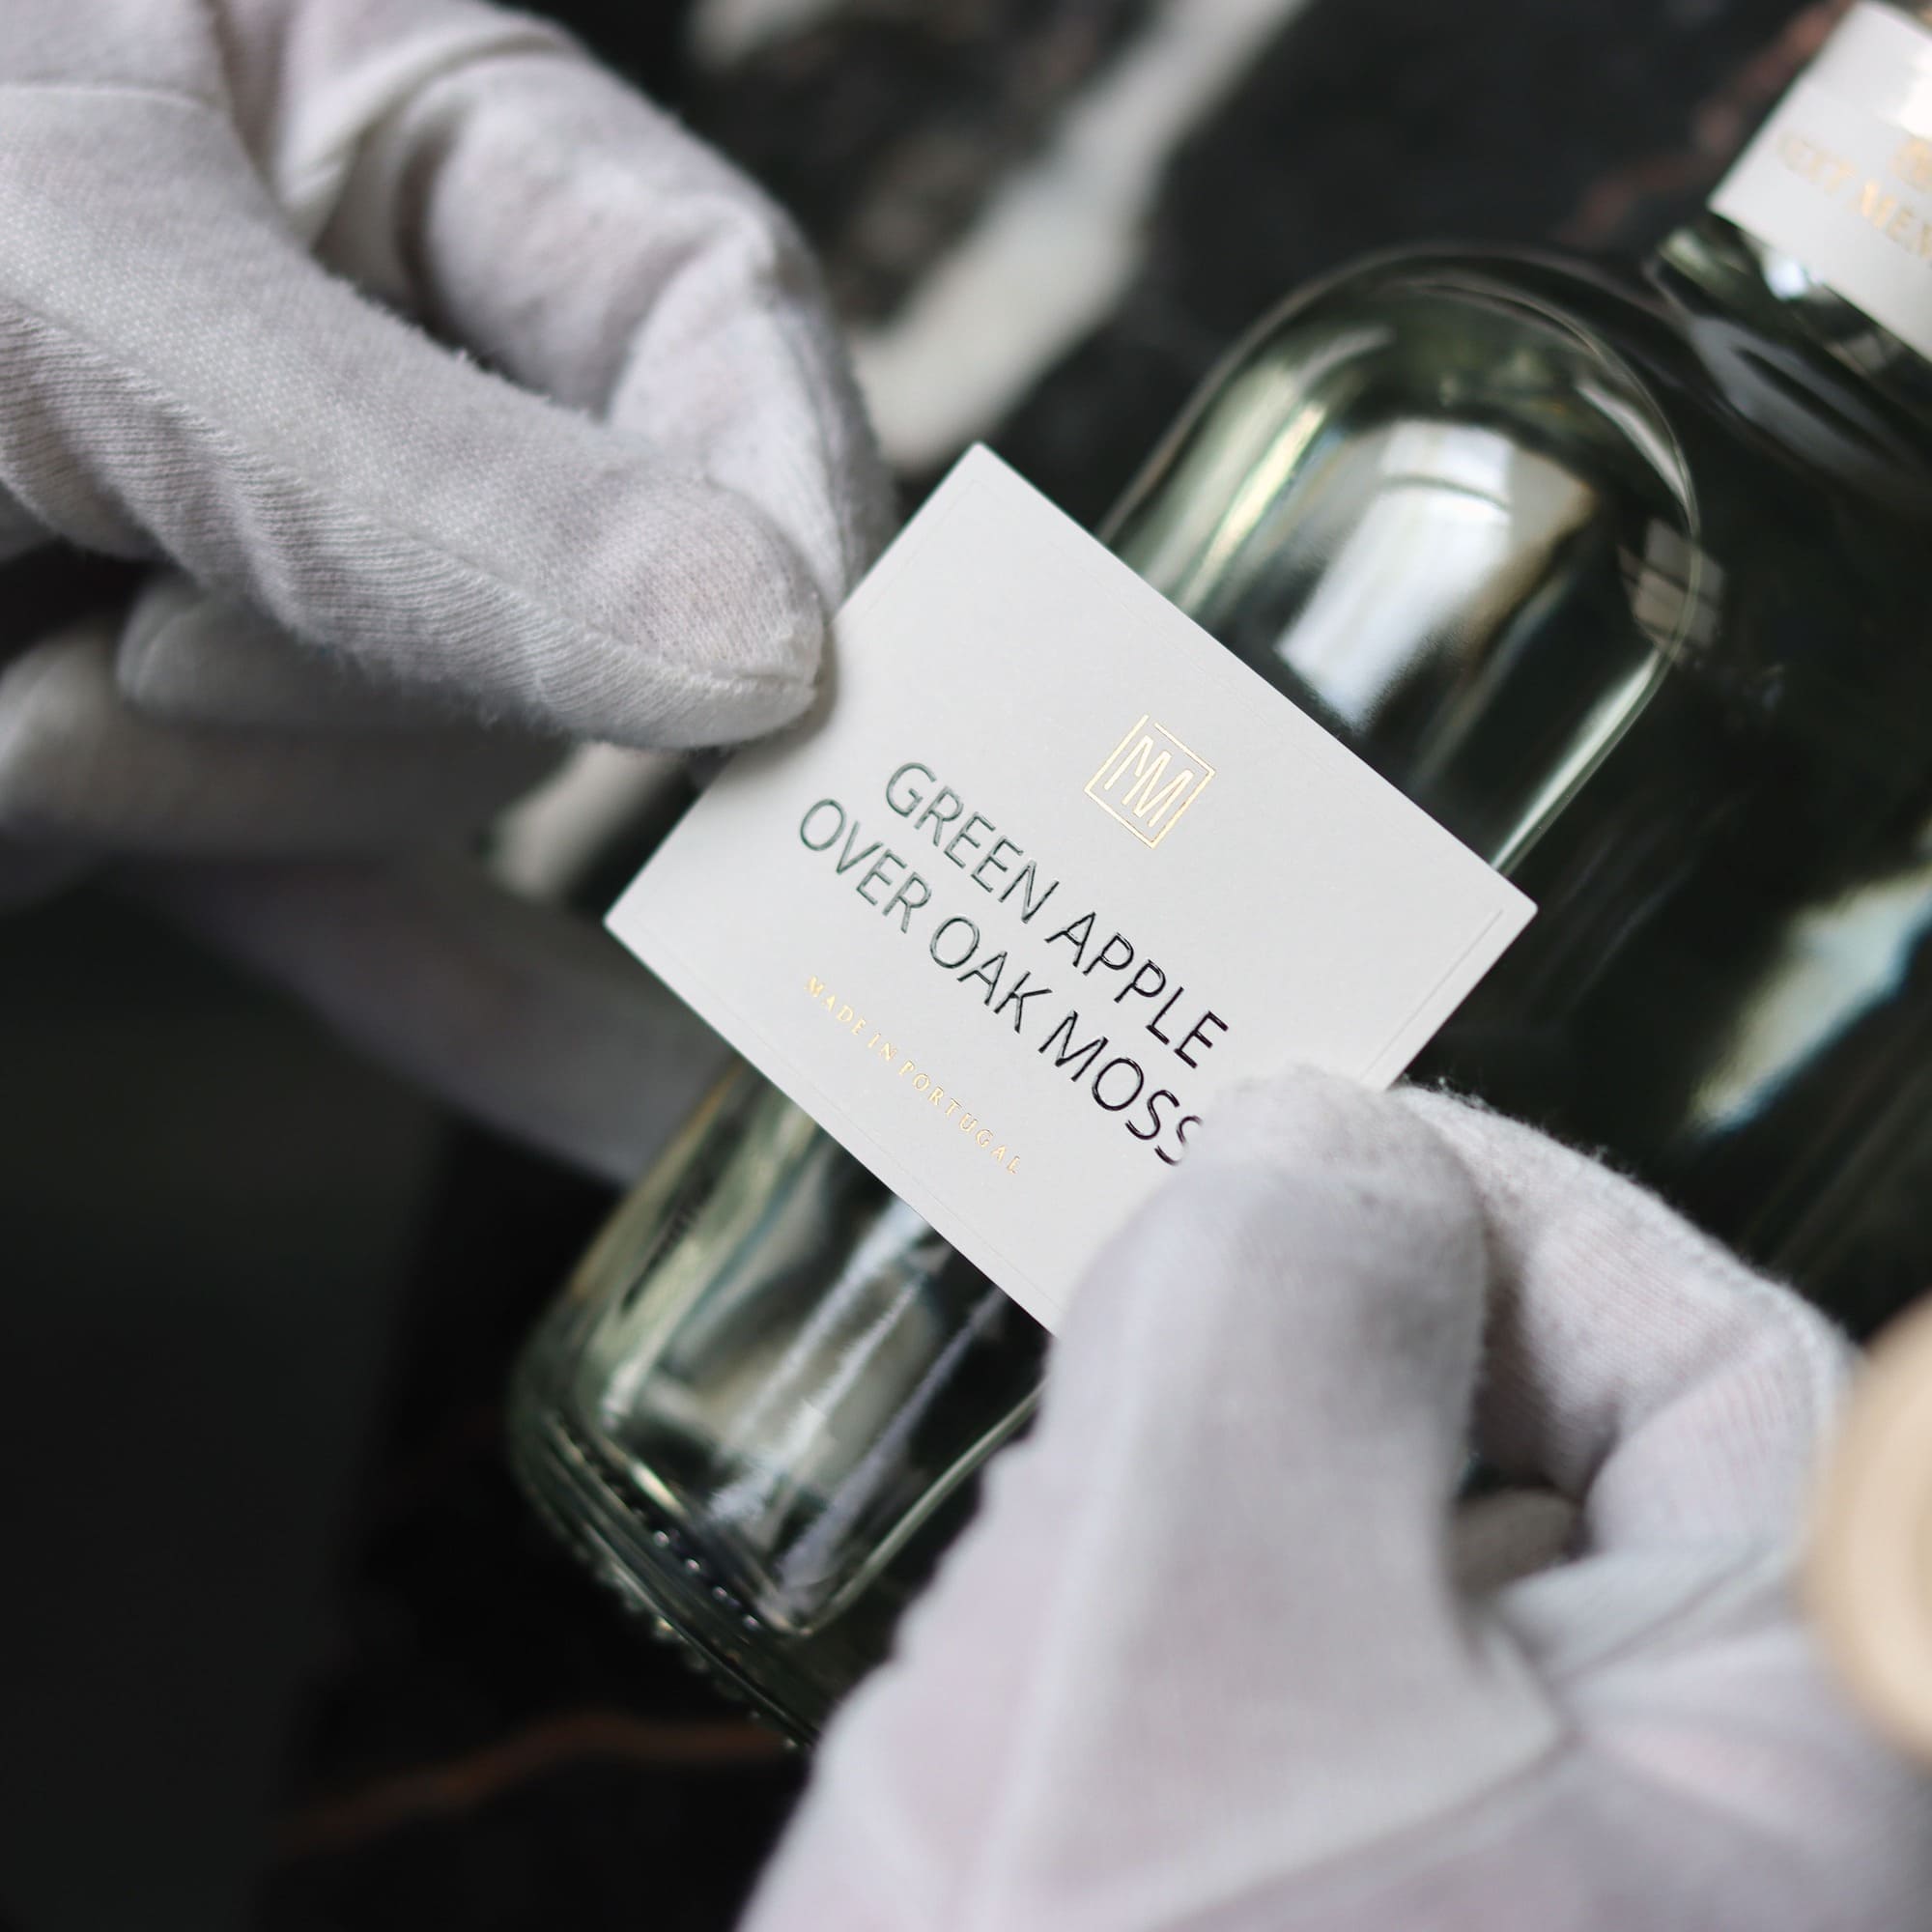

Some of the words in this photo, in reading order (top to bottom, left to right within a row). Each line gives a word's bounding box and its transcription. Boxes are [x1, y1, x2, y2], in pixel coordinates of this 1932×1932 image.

[799, 798, 933, 933] OVER
[929, 915, 1052, 1033] OAK
[1037, 1009, 1204, 1167] MOSS
[885, 761, 1060, 923] GREEN
[1044, 911, 1229, 1069] APPLE
[804, 975, 867, 1036] MADE
[867, 1033, 897, 1061] IN
[898, 1060, 1020, 1174] PORTUGAL
